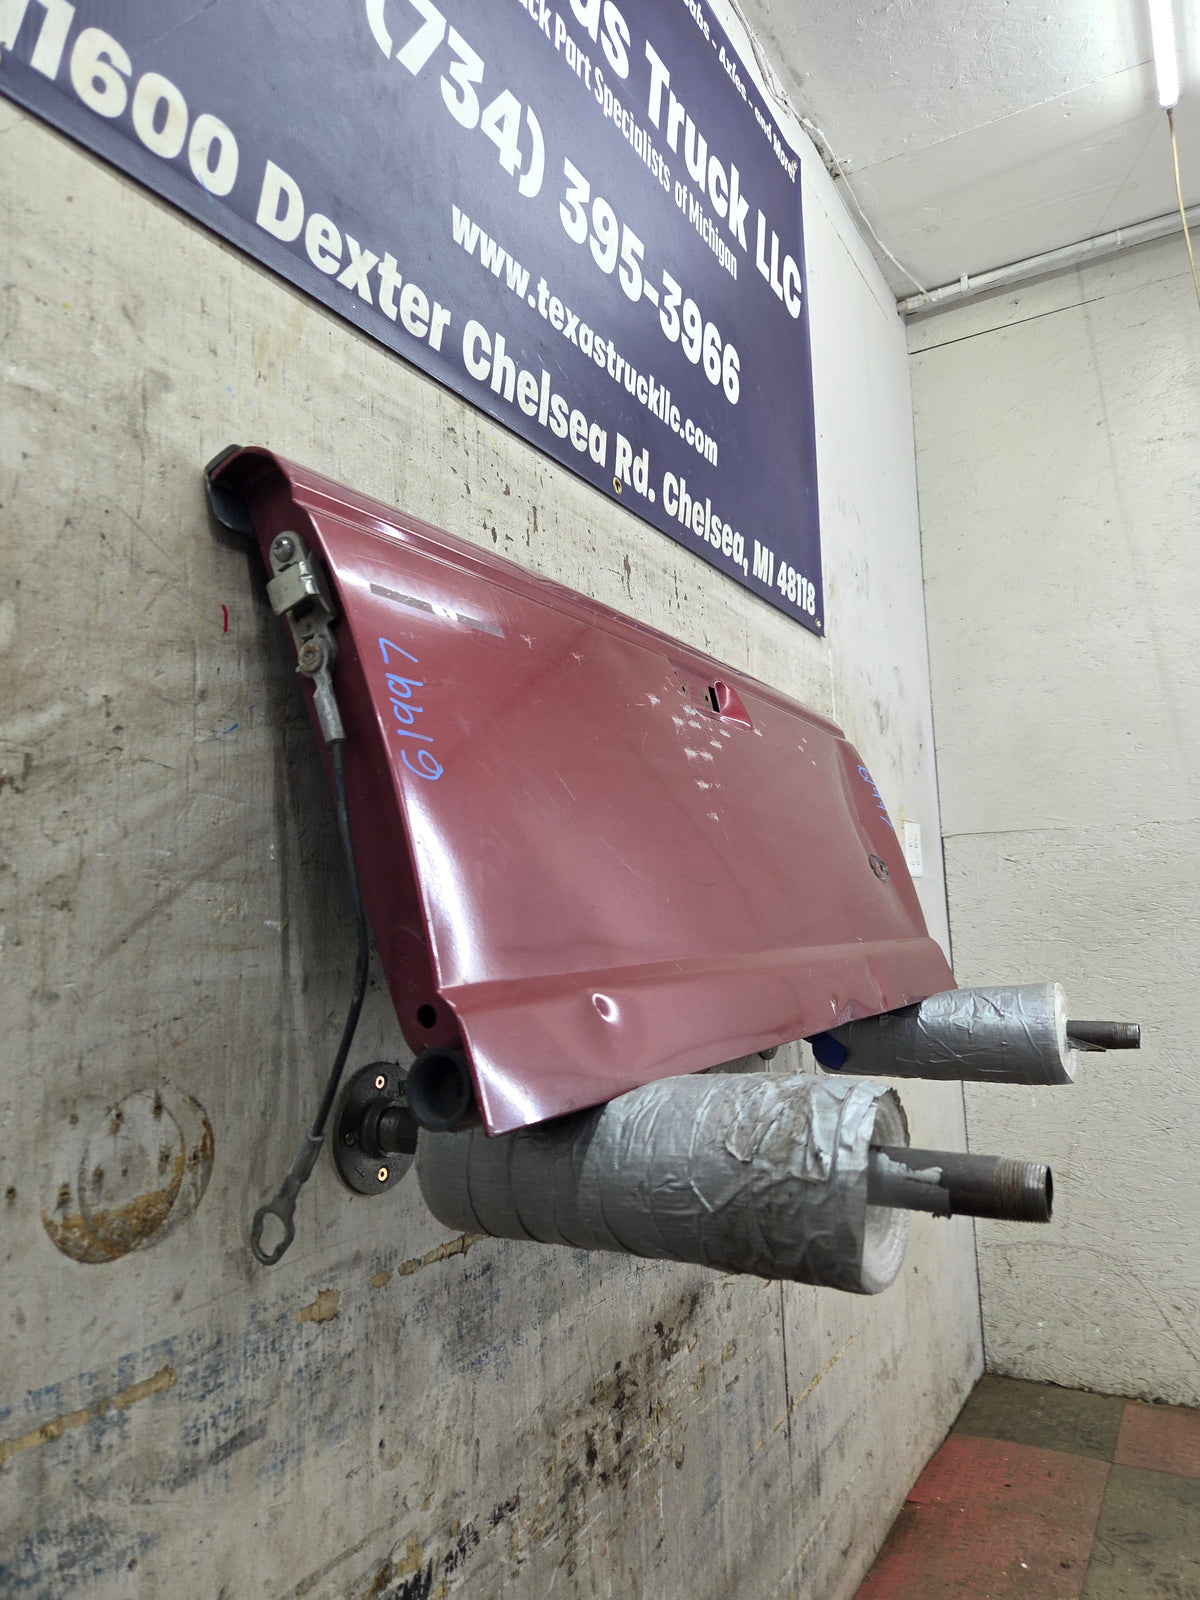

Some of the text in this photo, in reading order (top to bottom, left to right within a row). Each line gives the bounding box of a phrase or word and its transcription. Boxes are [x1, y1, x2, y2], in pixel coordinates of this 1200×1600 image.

[365, 0, 741, 405] (734) 395-3966
[555, 12, 592, 91] Part
[594, 66, 671, 192] Specialists
[675, 180, 688, 215] of
[689, 192, 737, 280] Michigan
[645, 39, 749, 253] Truck
[756, 209, 802, 319] LLC
[684, 0, 710, 41] abs
[719, 46, 747, 102] Axles
[754, 107, 772, 143] and
[256, 159, 452, 352] Dexter
[462, 319, 608, 468] Chelsea
[614, 432, 656, 503] Rd.
[663, 471, 748, 577] Chelsea,
[753, 539, 775, 588] MI
[777, 560, 816, 616] 48118
[451, 203, 719, 467] www.texastruckllc.com
[379, 637, 443, 780] 61997
